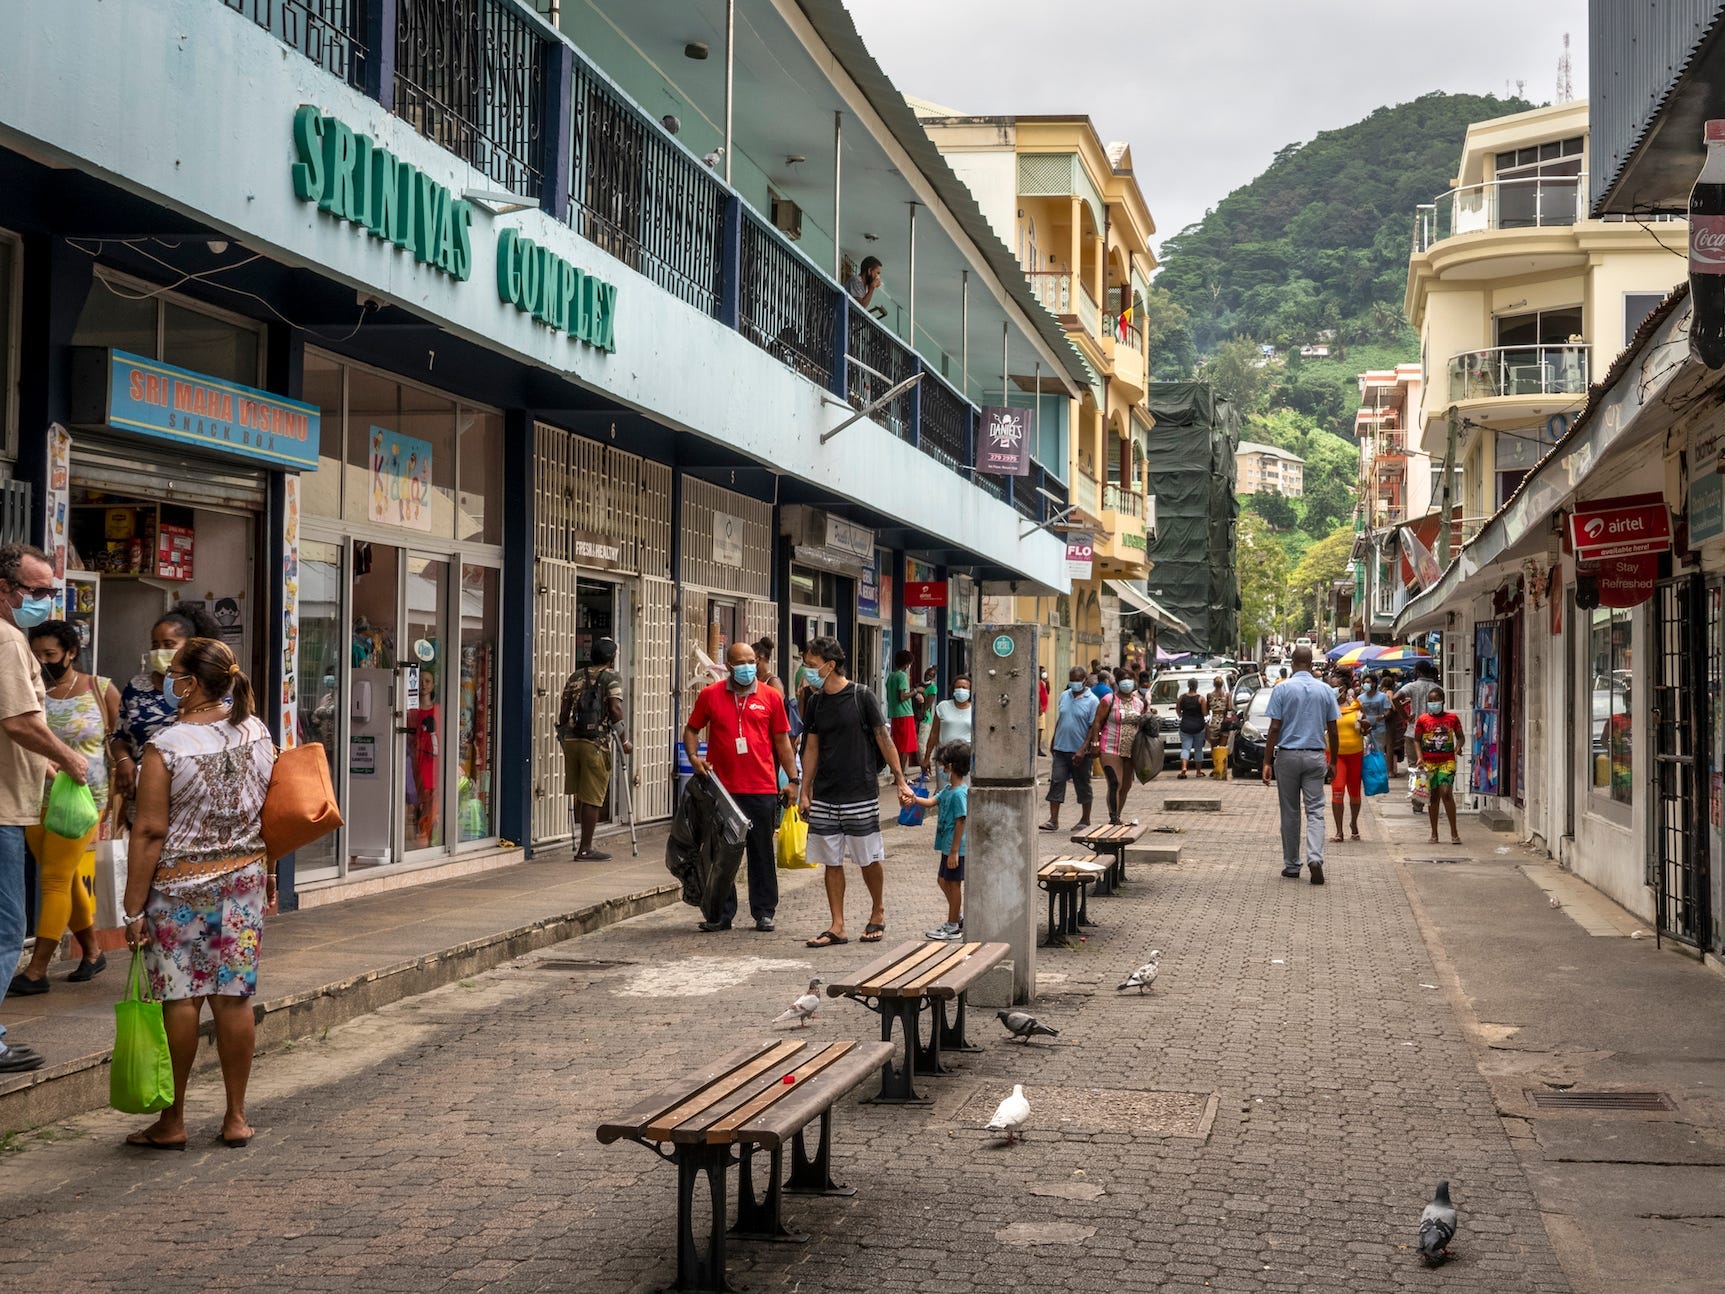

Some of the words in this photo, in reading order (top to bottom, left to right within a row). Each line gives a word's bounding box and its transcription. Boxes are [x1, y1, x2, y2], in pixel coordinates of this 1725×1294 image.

[292, 104, 473, 282] SRINIVAS
[497, 228, 618, 354] COMPLEX
[428, 350, 435, 371] 7
[129, 369, 168, 407] SRI
[173, 379, 233, 423] MAHA
[238, 397, 309, 441] VISHNU
[169, 412, 230, 440] SNACK
[243, 432, 275, 450] BOX
[610, 422, 616, 440] 6
[1608, 517, 1645, 534] airtel
[1067, 545, 1092, 556] FLO
[1600, 546, 1633, 556] available
[1633, 543, 1651, 554] here!
[1616, 561, 1639, 574] Stay
[1601, 578, 1653, 589] Refreshed
